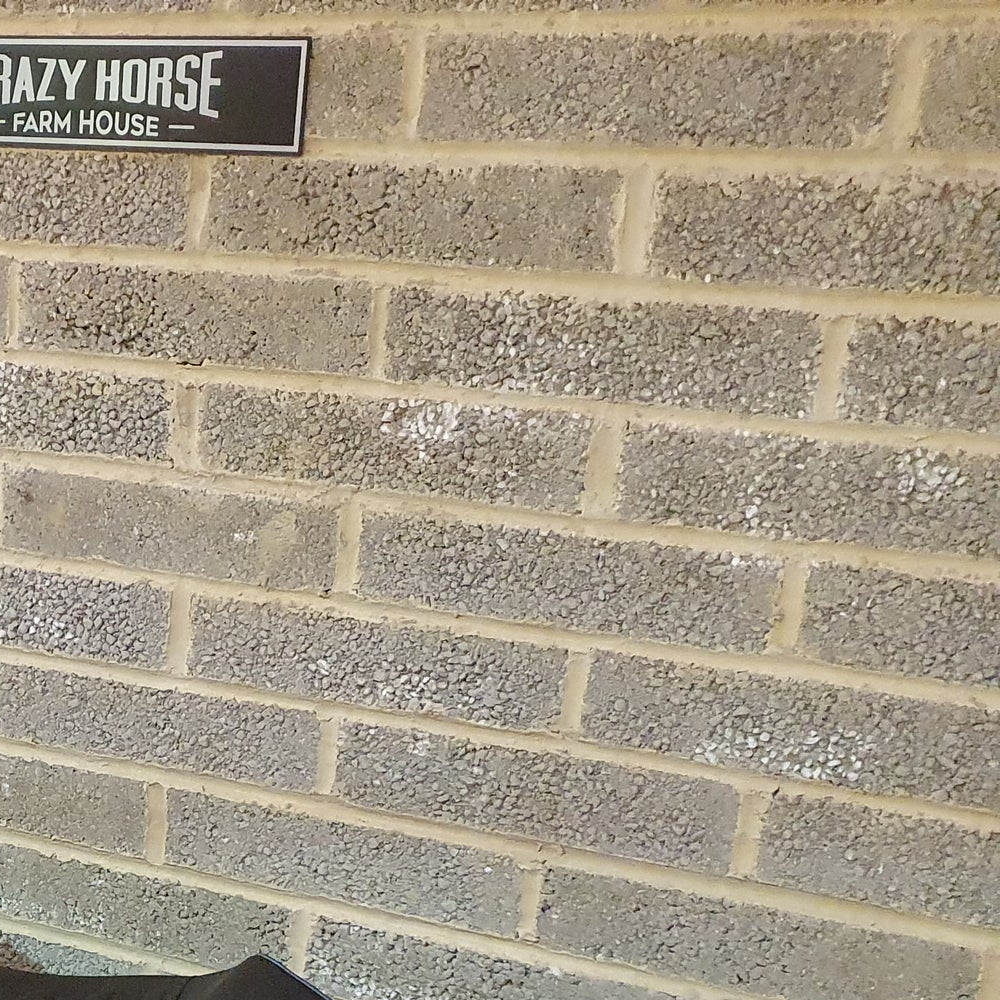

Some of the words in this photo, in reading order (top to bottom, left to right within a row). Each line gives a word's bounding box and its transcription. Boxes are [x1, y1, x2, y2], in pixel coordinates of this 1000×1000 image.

[95, 50, 223, 119] HORSE
[13, 109, 72, 134] FARM
[79, 109, 160, 137] HOUSE
